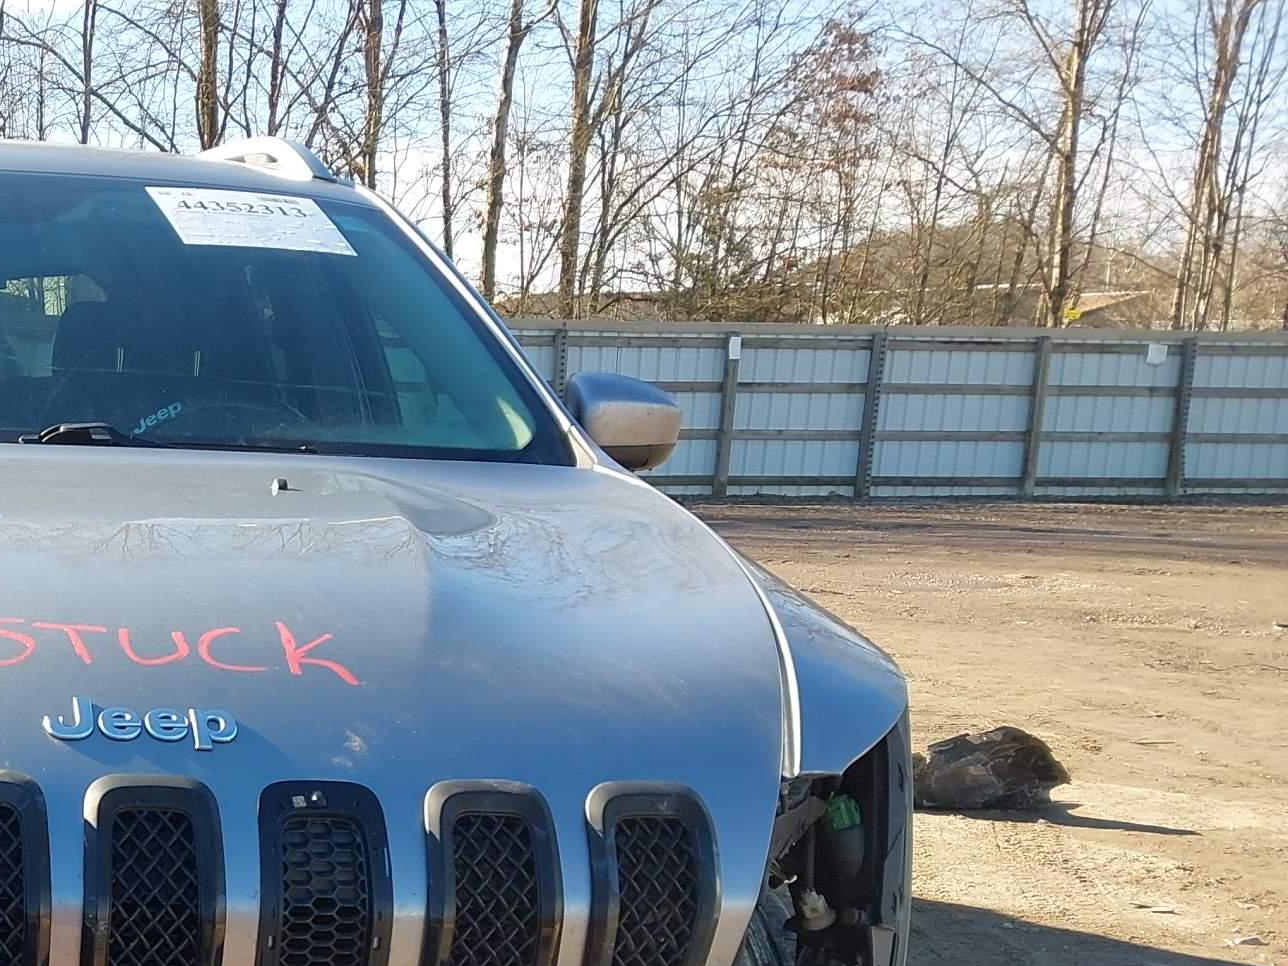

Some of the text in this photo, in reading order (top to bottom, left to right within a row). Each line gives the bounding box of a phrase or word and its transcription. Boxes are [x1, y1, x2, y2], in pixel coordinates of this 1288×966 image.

[177, 200, 307, 218] 44352313
[134, 402, 181, 434] Jeep
[43, 696, 238, 751] Jeep
